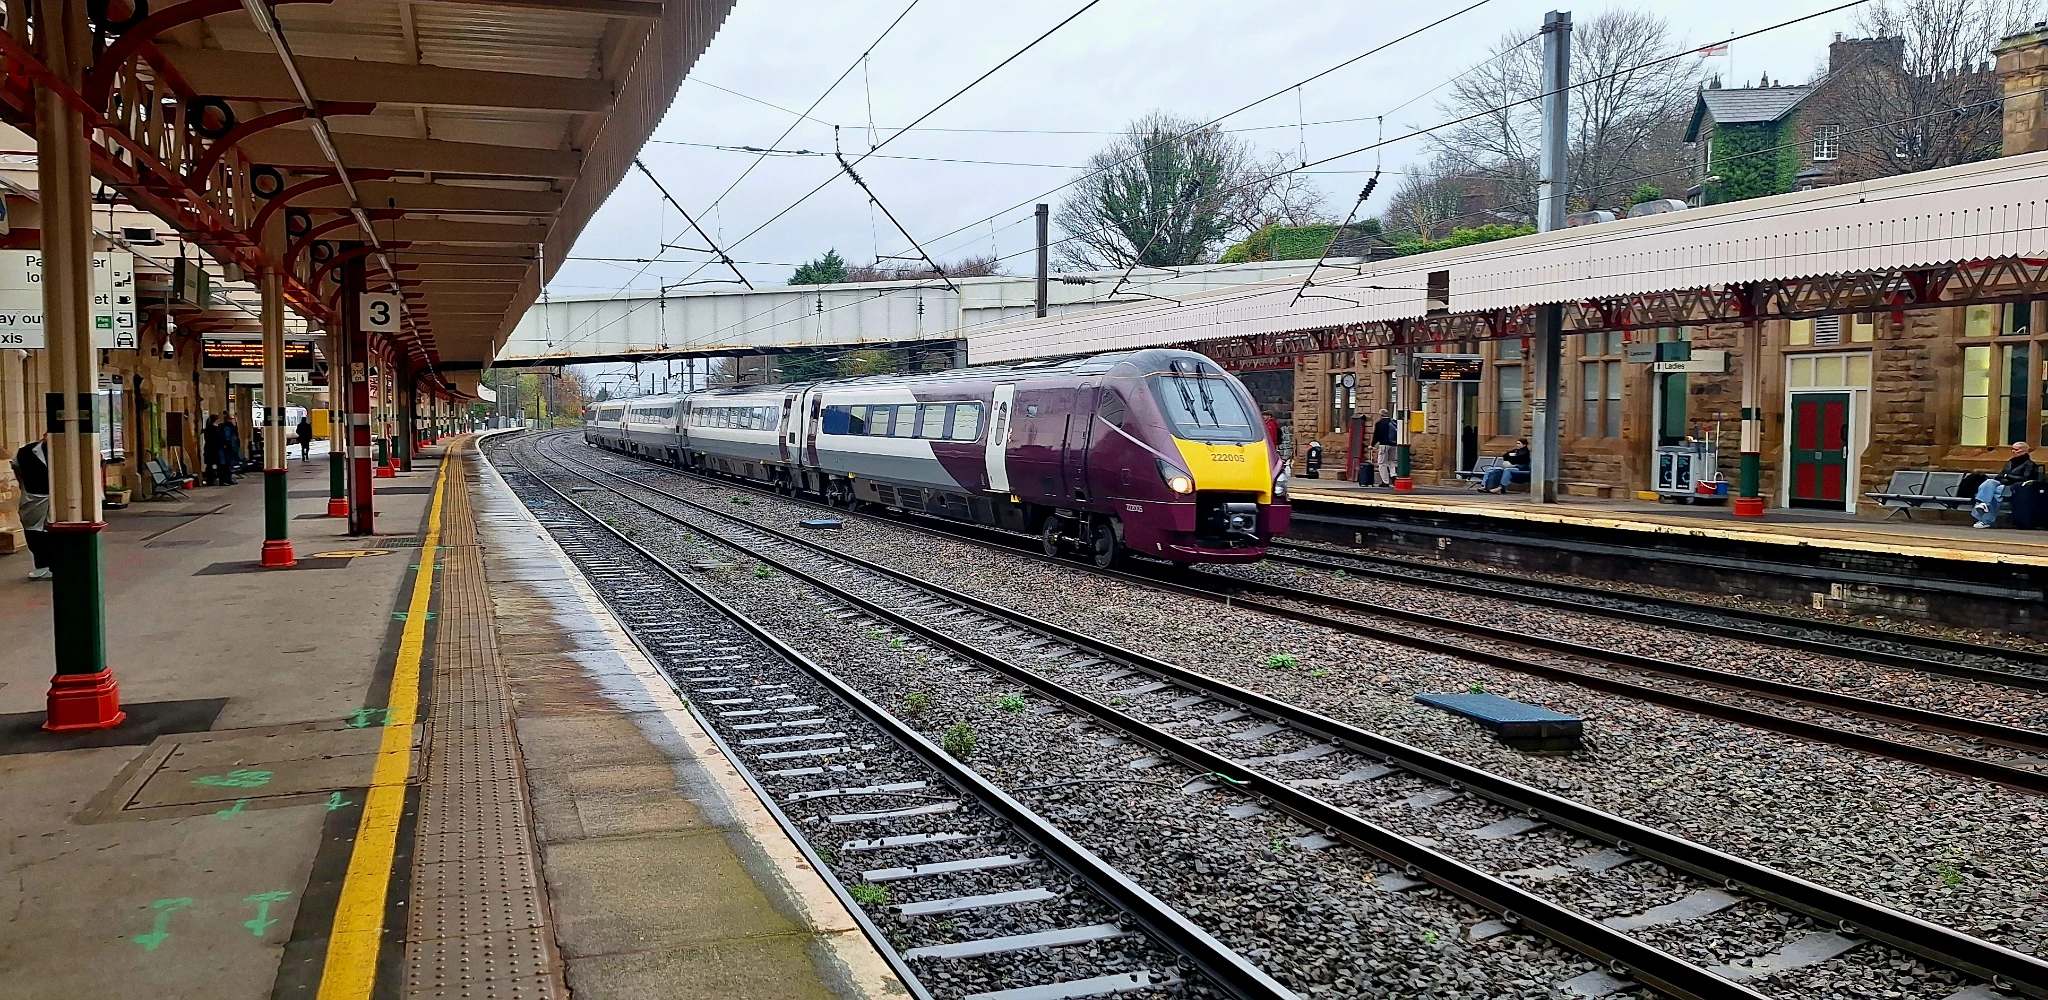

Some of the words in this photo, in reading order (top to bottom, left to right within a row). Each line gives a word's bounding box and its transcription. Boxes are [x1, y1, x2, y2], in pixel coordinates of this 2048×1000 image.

[369, 300, 391, 326] 3
[0, 332, 23, 344] xis
[1664, 362, 1685, 370] Ladies
[255, 411, 262, 419] 2
[1210, 453, 1245, 463] 222005
